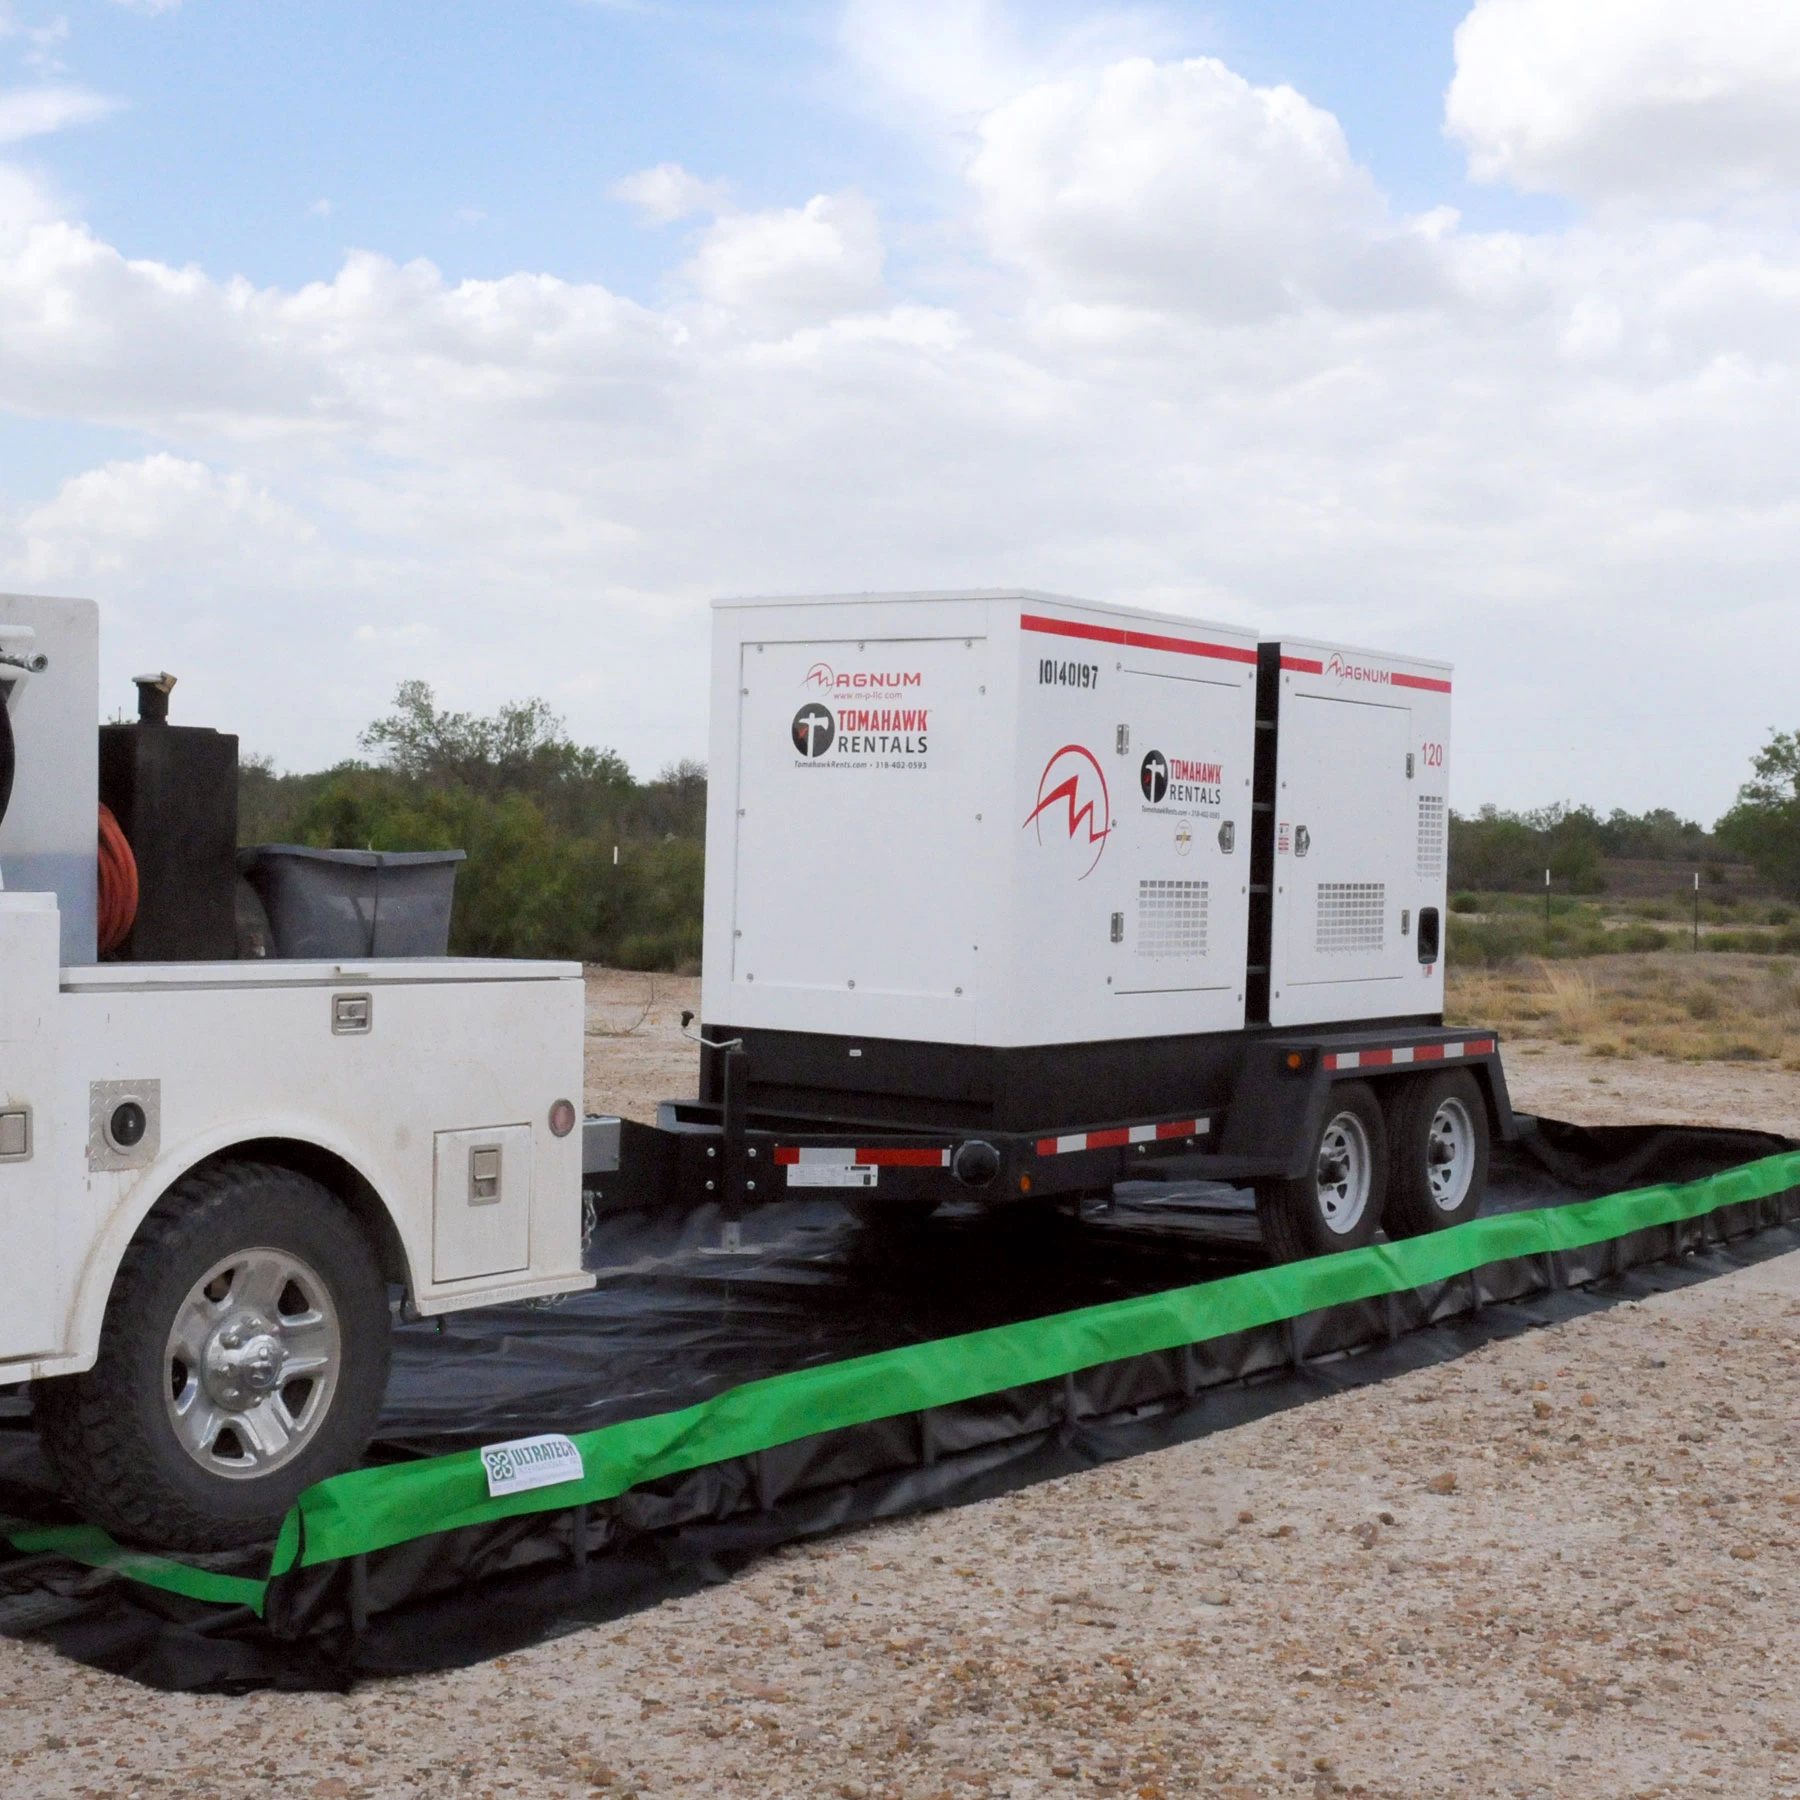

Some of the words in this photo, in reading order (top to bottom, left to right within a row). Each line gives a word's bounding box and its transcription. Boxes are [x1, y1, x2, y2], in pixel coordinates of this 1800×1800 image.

[1039, 659, 1098, 689] 10140197
[837, 710, 928, 731] TOMAHAWK
[838, 736, 928, 754] RENTALS
[1422, 742, 1443, 767] 120
[1170, 758, 1221, 785] TOMAHAWK
[1170, 784, 1221, 805] RENTALS
[511, 1441, 577, 1466] ULTRATECH
